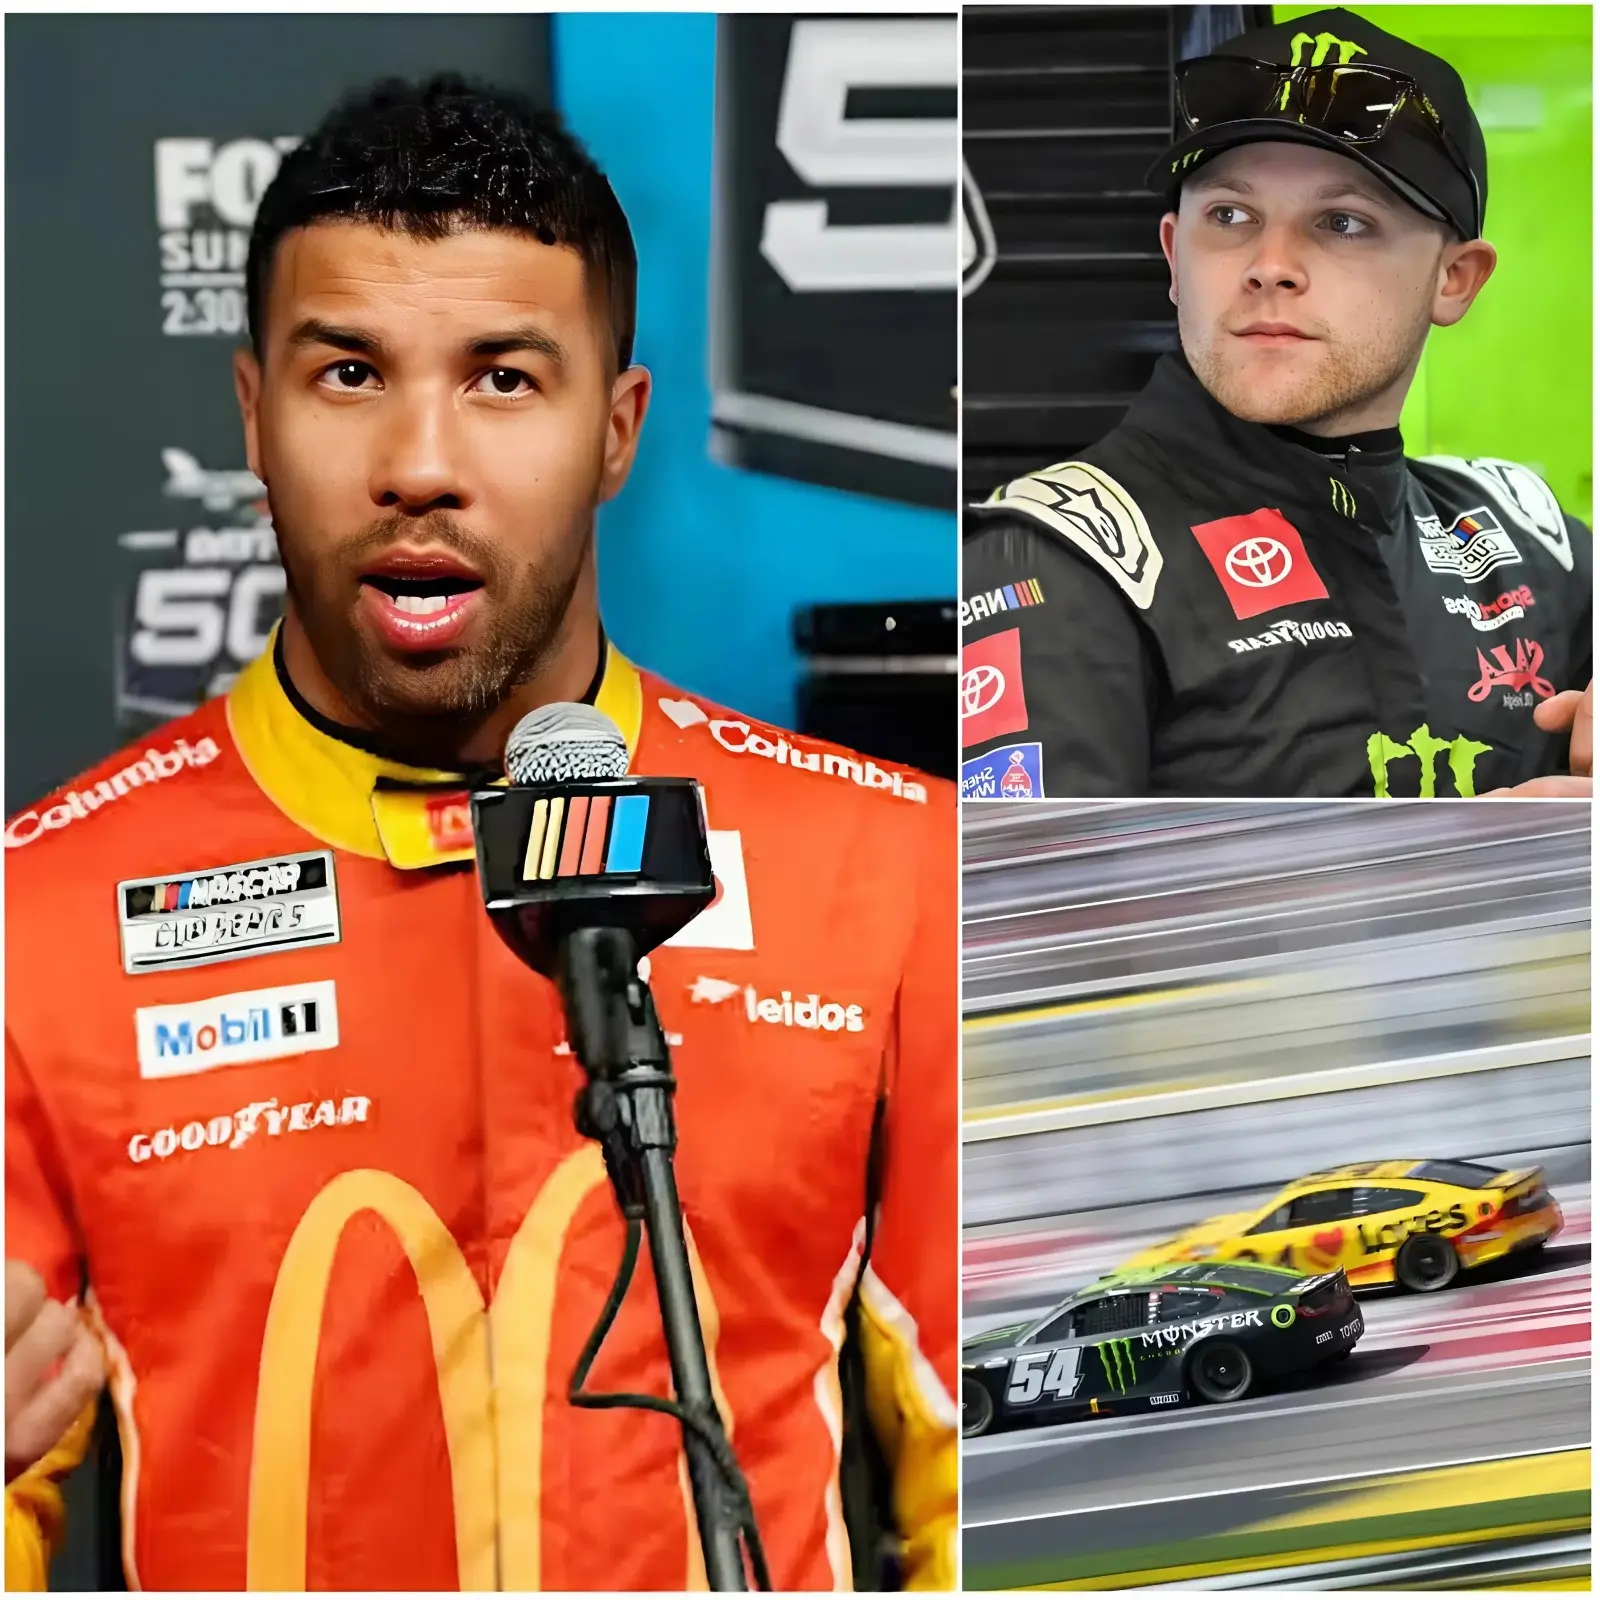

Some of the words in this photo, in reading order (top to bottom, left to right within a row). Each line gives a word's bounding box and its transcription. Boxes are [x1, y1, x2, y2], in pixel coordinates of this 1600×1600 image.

[154, 136, 302, 229] FO
[4, 738, 221, 848] Columbia
[708, 719, 927, 804] Columbia
[155, 1007, 271, 1057] Mobil
[744, 984, 864, 1032] leidos
[128, 1096, 371, 1162] GOODYEAR
[1007, 1347, 1085, 1404] 54
